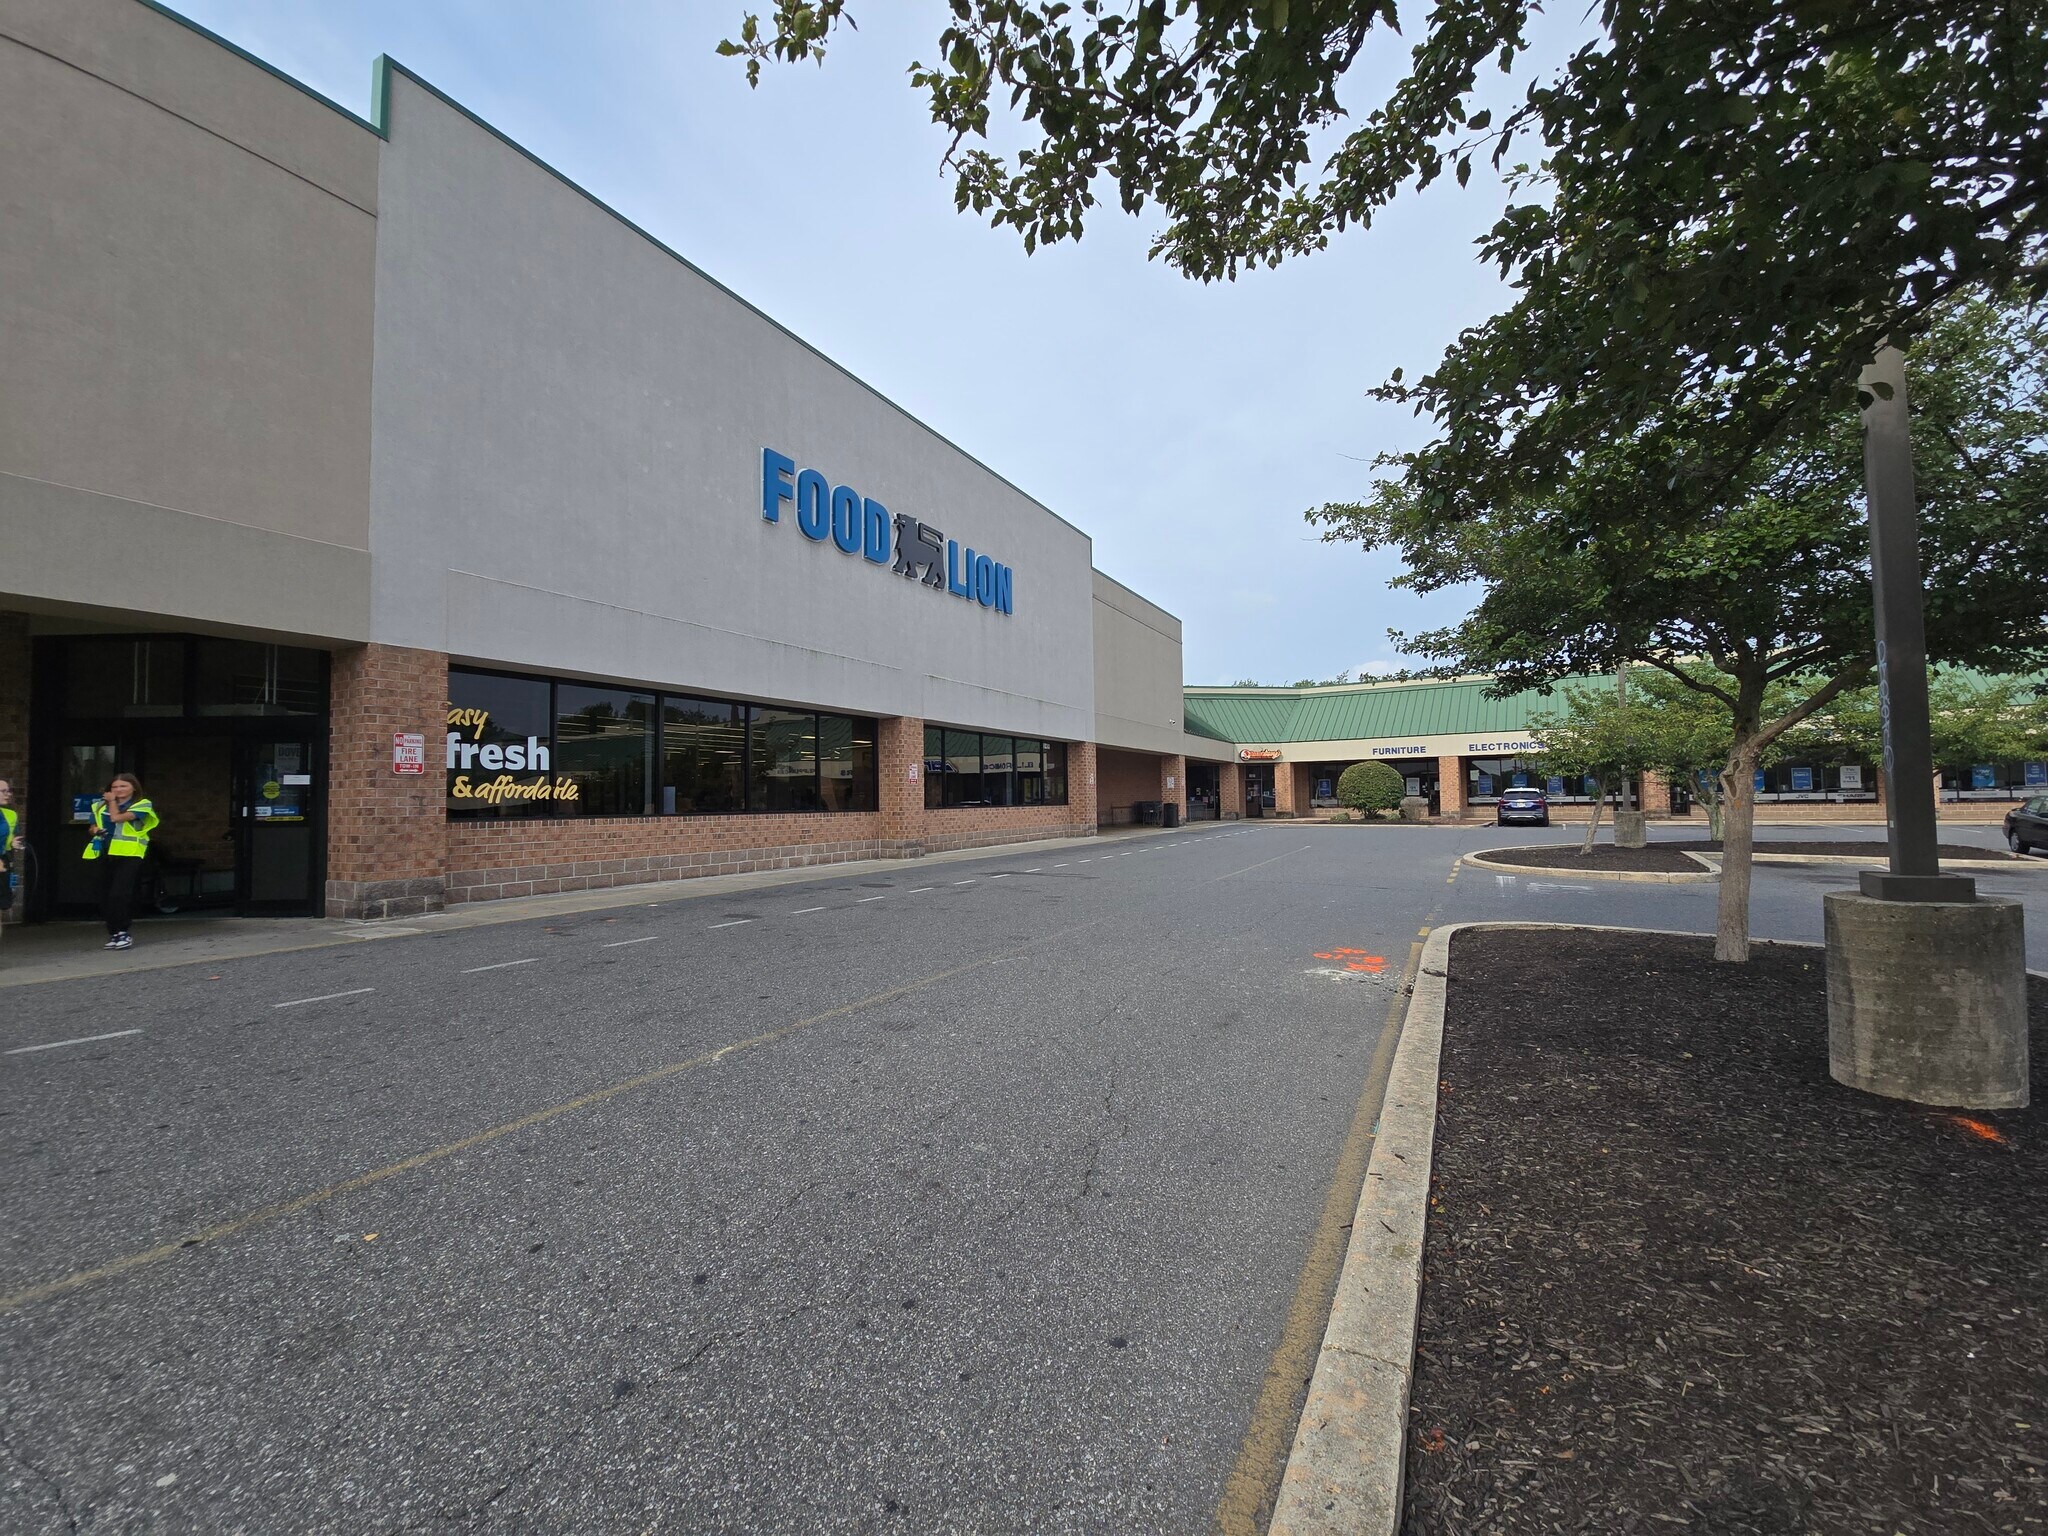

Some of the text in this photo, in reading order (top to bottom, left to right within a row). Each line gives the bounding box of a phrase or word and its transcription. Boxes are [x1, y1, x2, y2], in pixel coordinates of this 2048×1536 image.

[761, 446, 1013, 616] FOOD LION
[447, 701, 489, 740] asy
[446, 731, 550, 771] fresh
[1372, 745, 1427, 756] FURNITURE
[1468, 741, 1545, 752] ELECTRONICS
[452, 776, 473, 799] &
